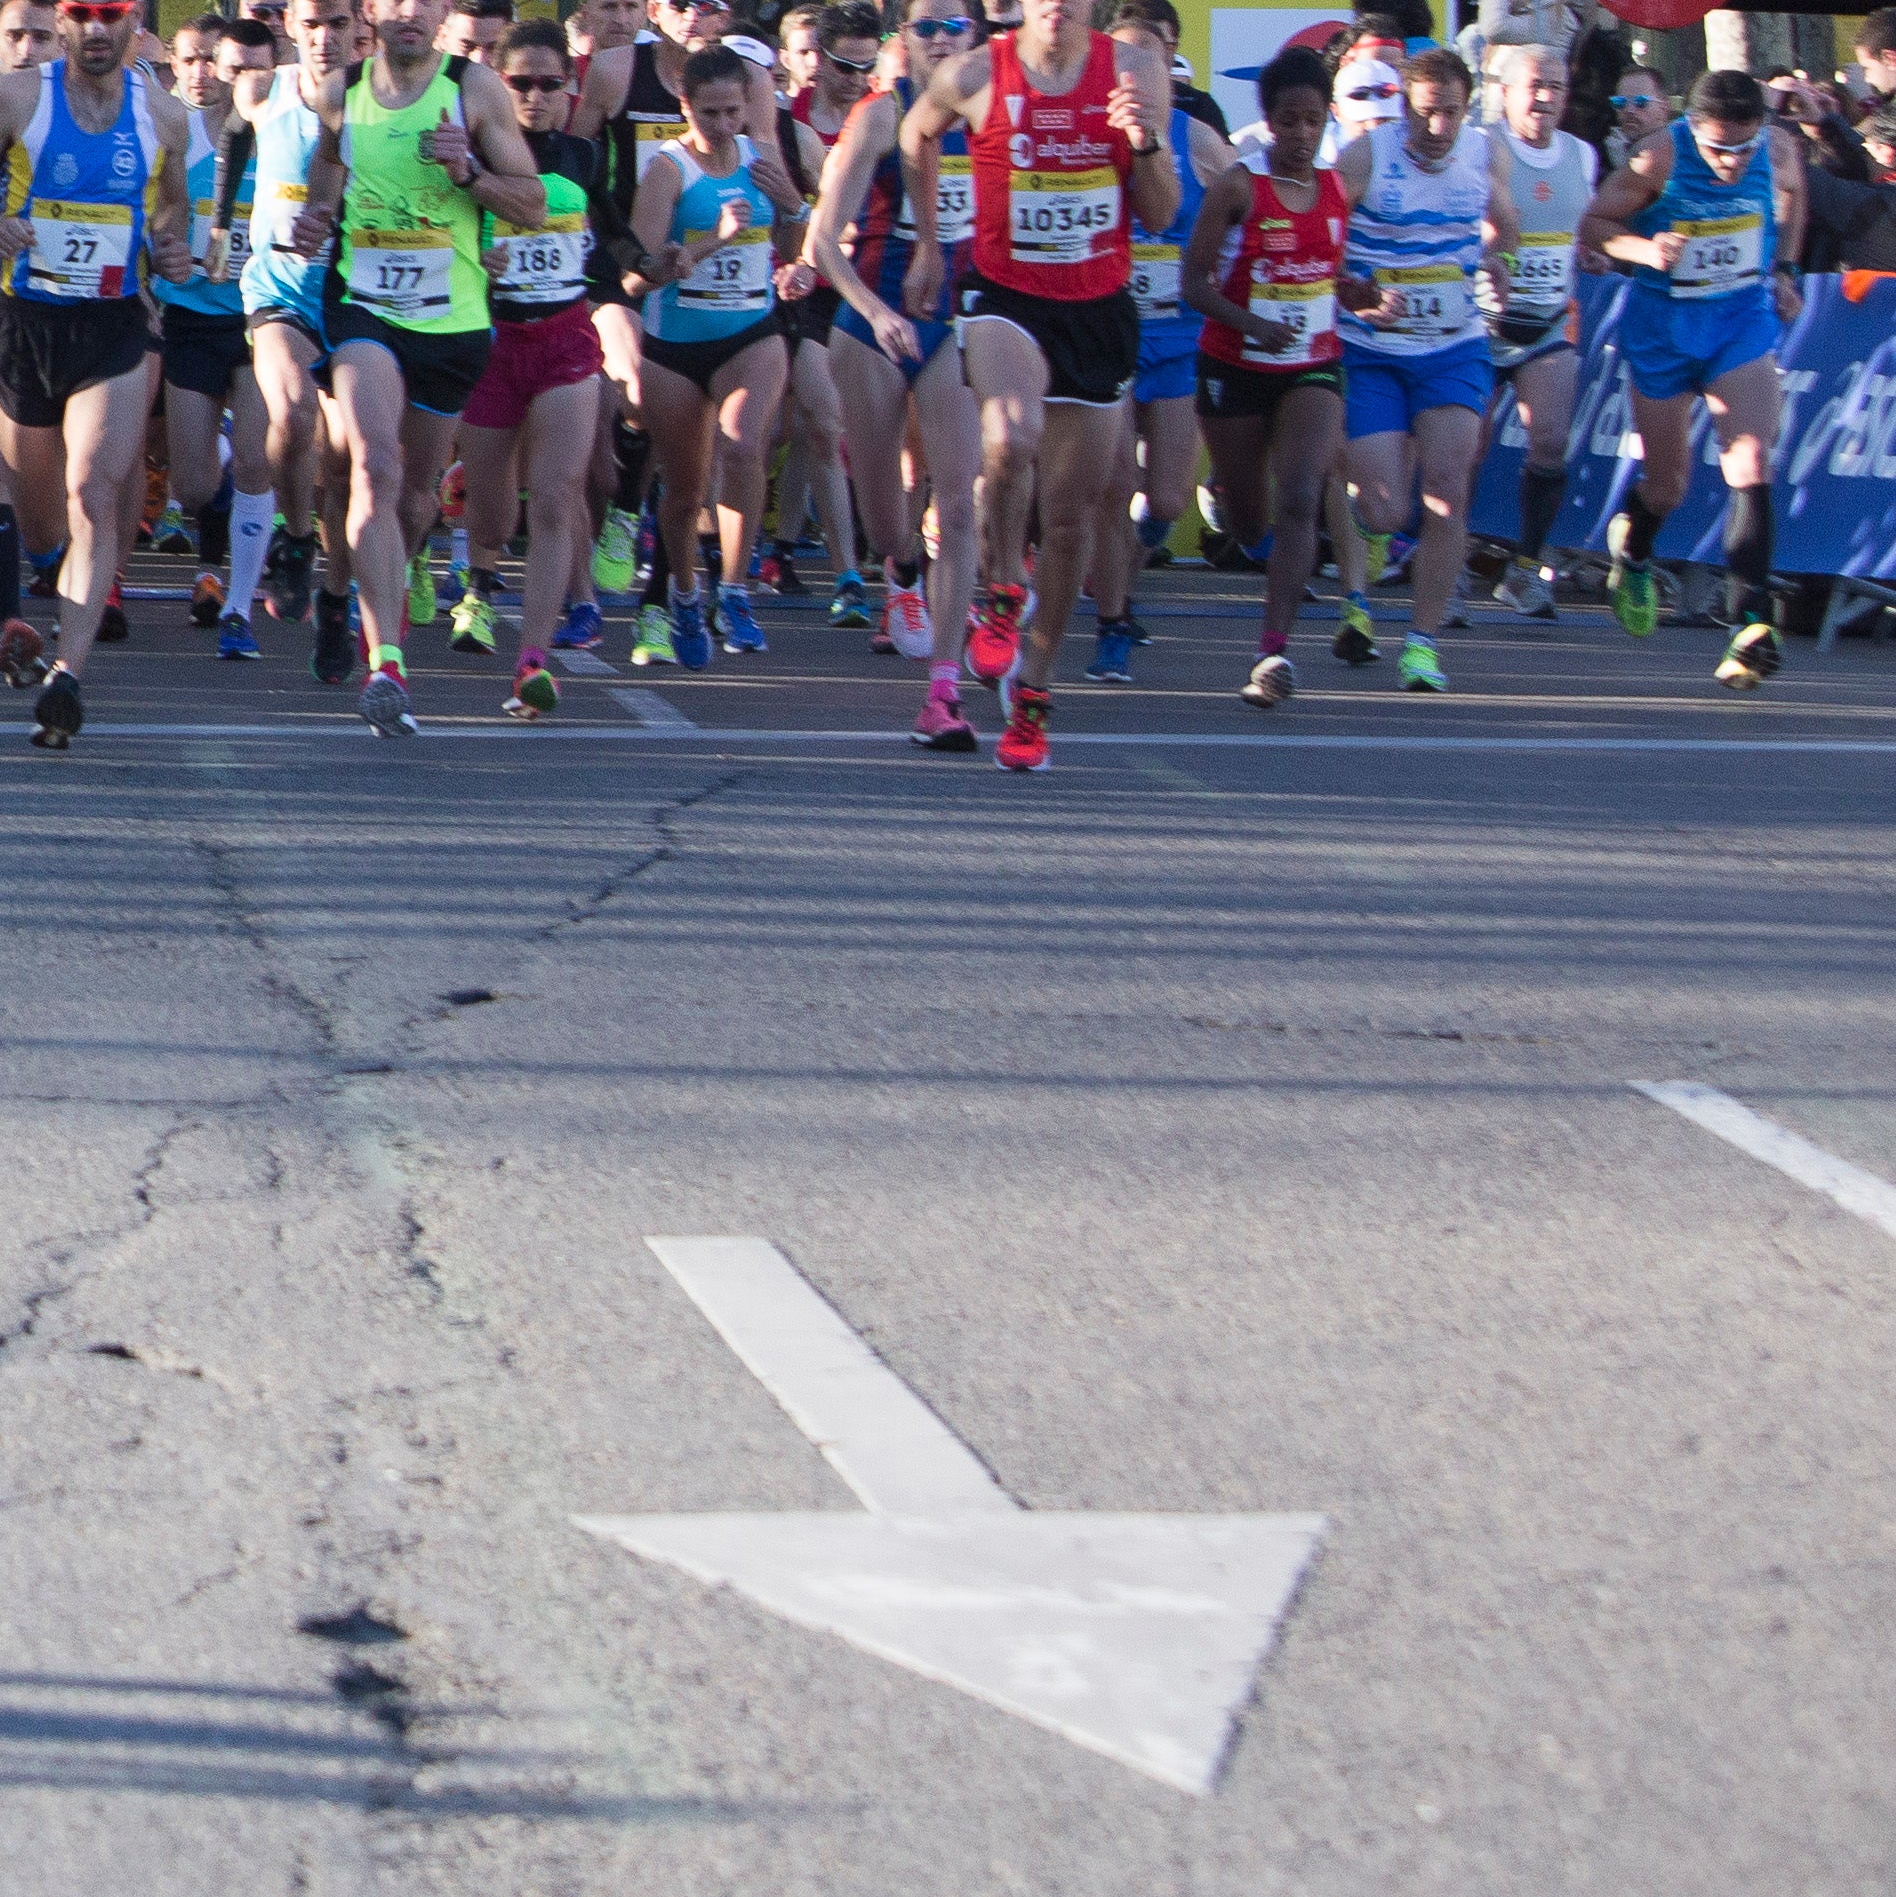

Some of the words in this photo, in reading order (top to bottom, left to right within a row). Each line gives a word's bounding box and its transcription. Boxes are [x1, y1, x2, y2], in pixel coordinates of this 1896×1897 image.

[1017, 204, 1111, 232] 10345
[63, 239, 99, 264] 27
[377, 266, 425, 289] 177
[713, 260, 741, 281] 19
